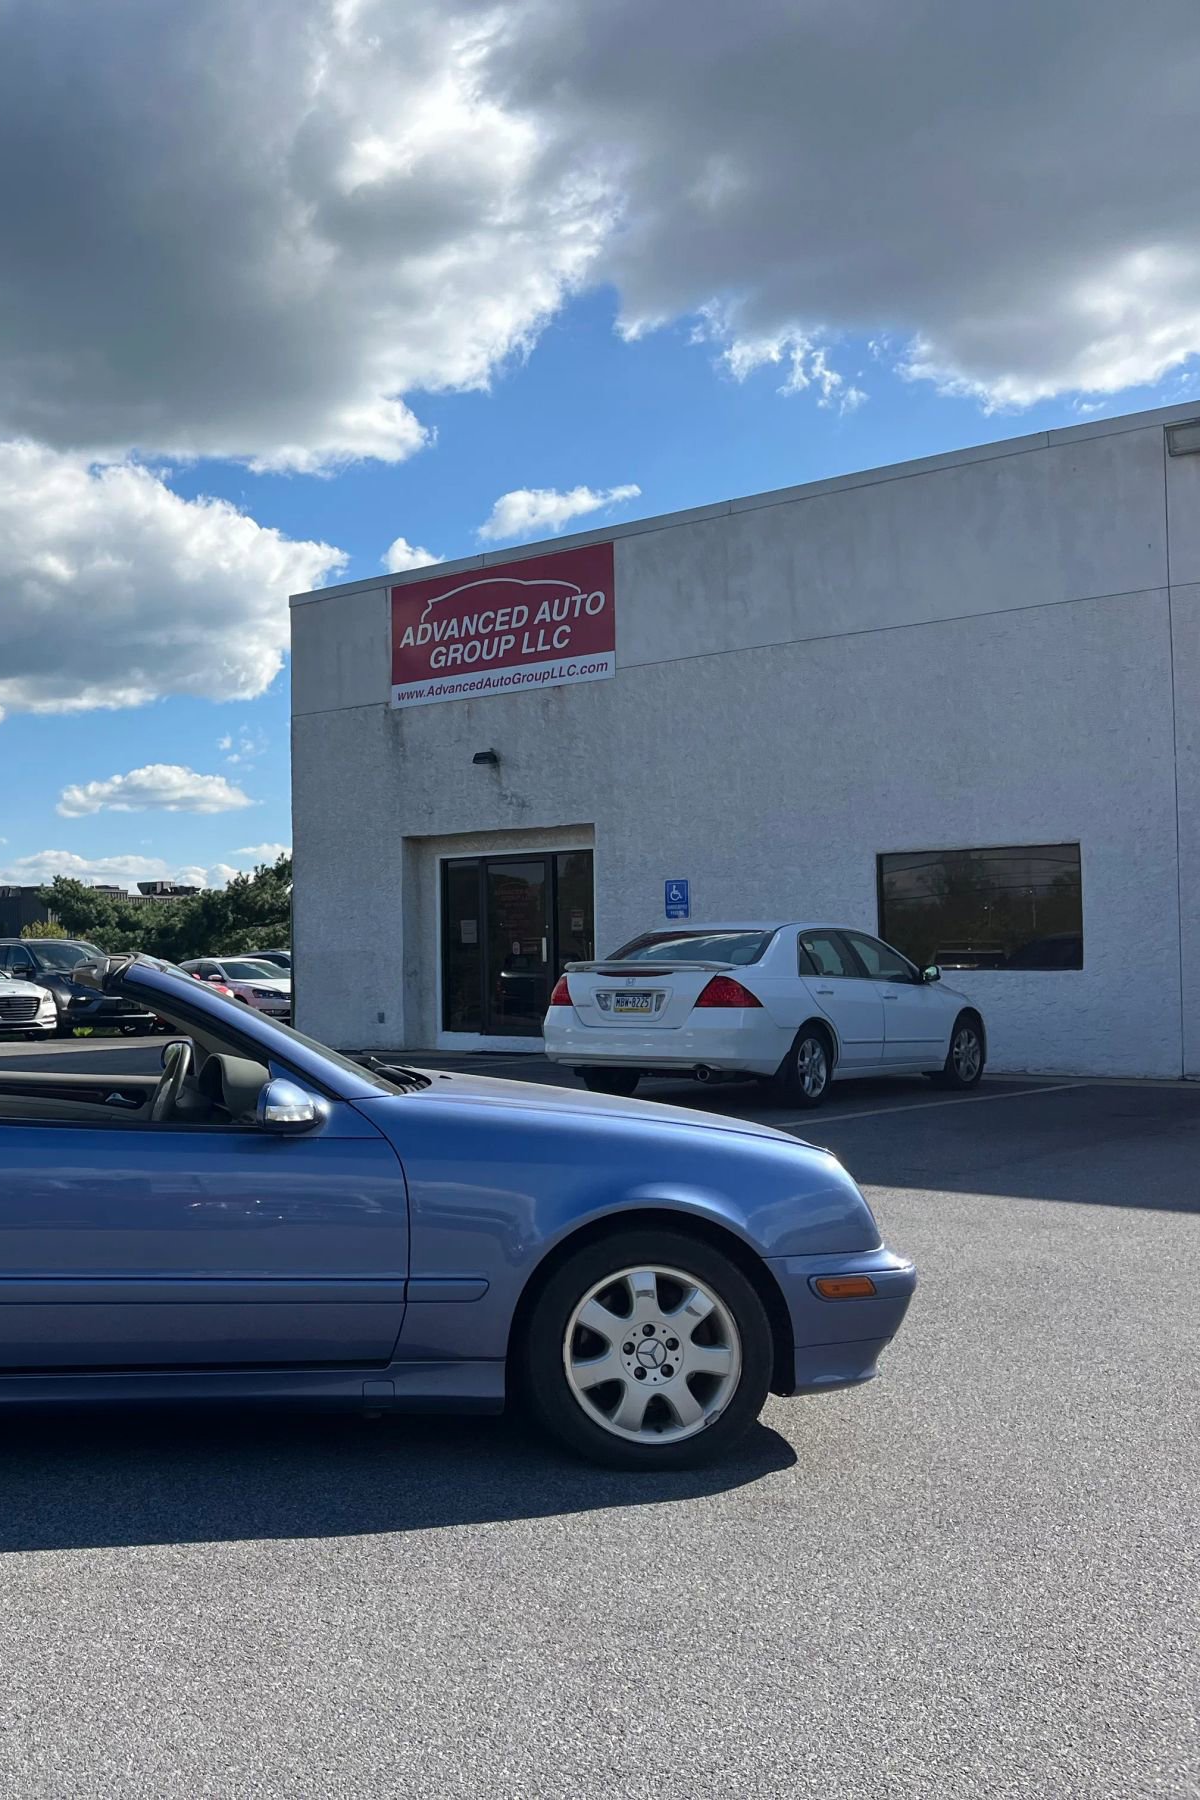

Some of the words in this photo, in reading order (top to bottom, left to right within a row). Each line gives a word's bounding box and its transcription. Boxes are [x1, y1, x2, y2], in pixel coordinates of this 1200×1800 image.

[399, 605, 529, 649] ADVANCED
[533, 590, 606, 625] AUTO
[429, 634, 516, 670] GROUP
[521, 625, 572, 654] LLC
[397, 660, 609, 702] www.AdvancedAutoGroupLLC.com
